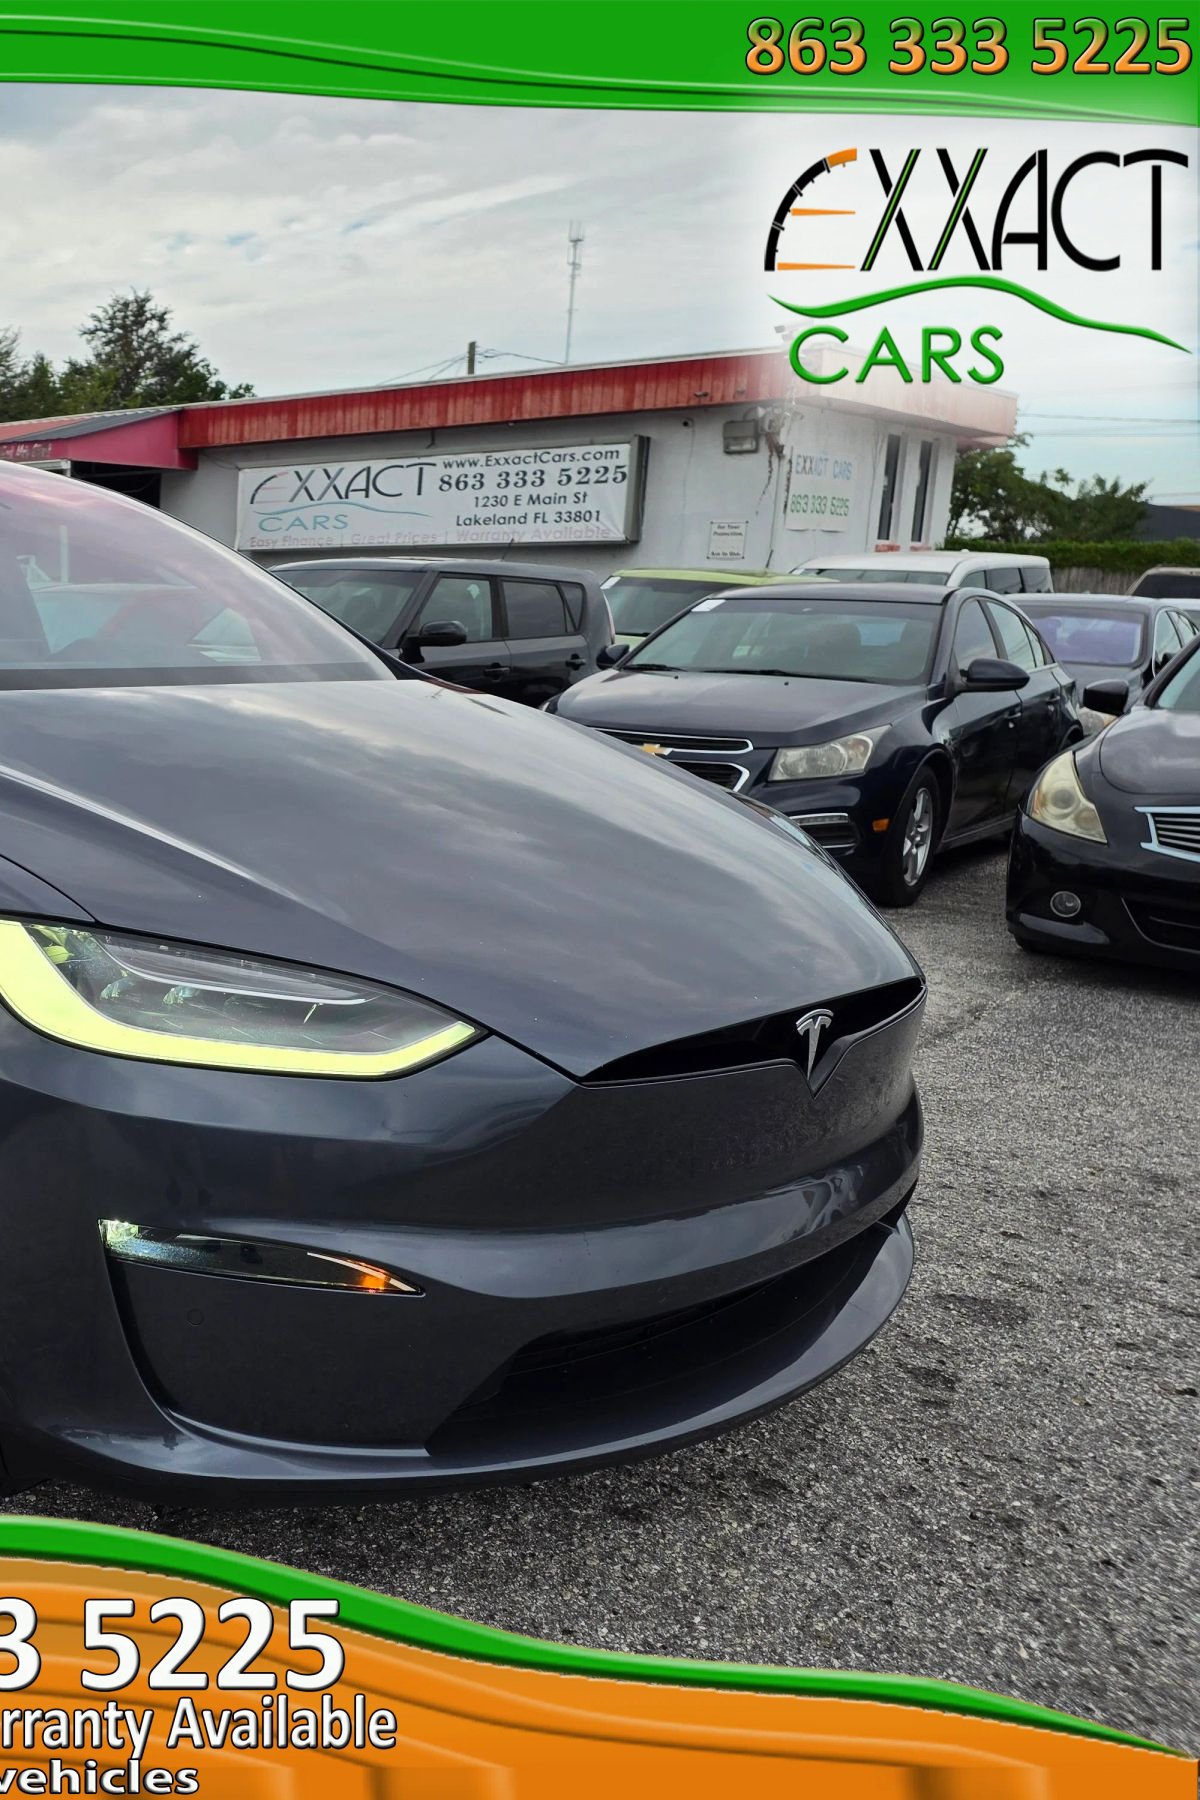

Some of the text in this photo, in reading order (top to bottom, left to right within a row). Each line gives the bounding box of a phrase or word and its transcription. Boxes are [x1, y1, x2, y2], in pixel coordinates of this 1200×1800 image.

[442, 449, 620, 469] www.ExxactCars.com
[250, 462, 437, 505] EXXACT
[438, 464, 628, 492] 863 333 5225
[474, 491, 588, 508] 1230 E Main St
[258, 514, 349, 533] CARS
[456, 509, 601, 526] Lakeland FL 33801
[250, 525, 612, 548] Easy Finance Great Prices Warranty Available
